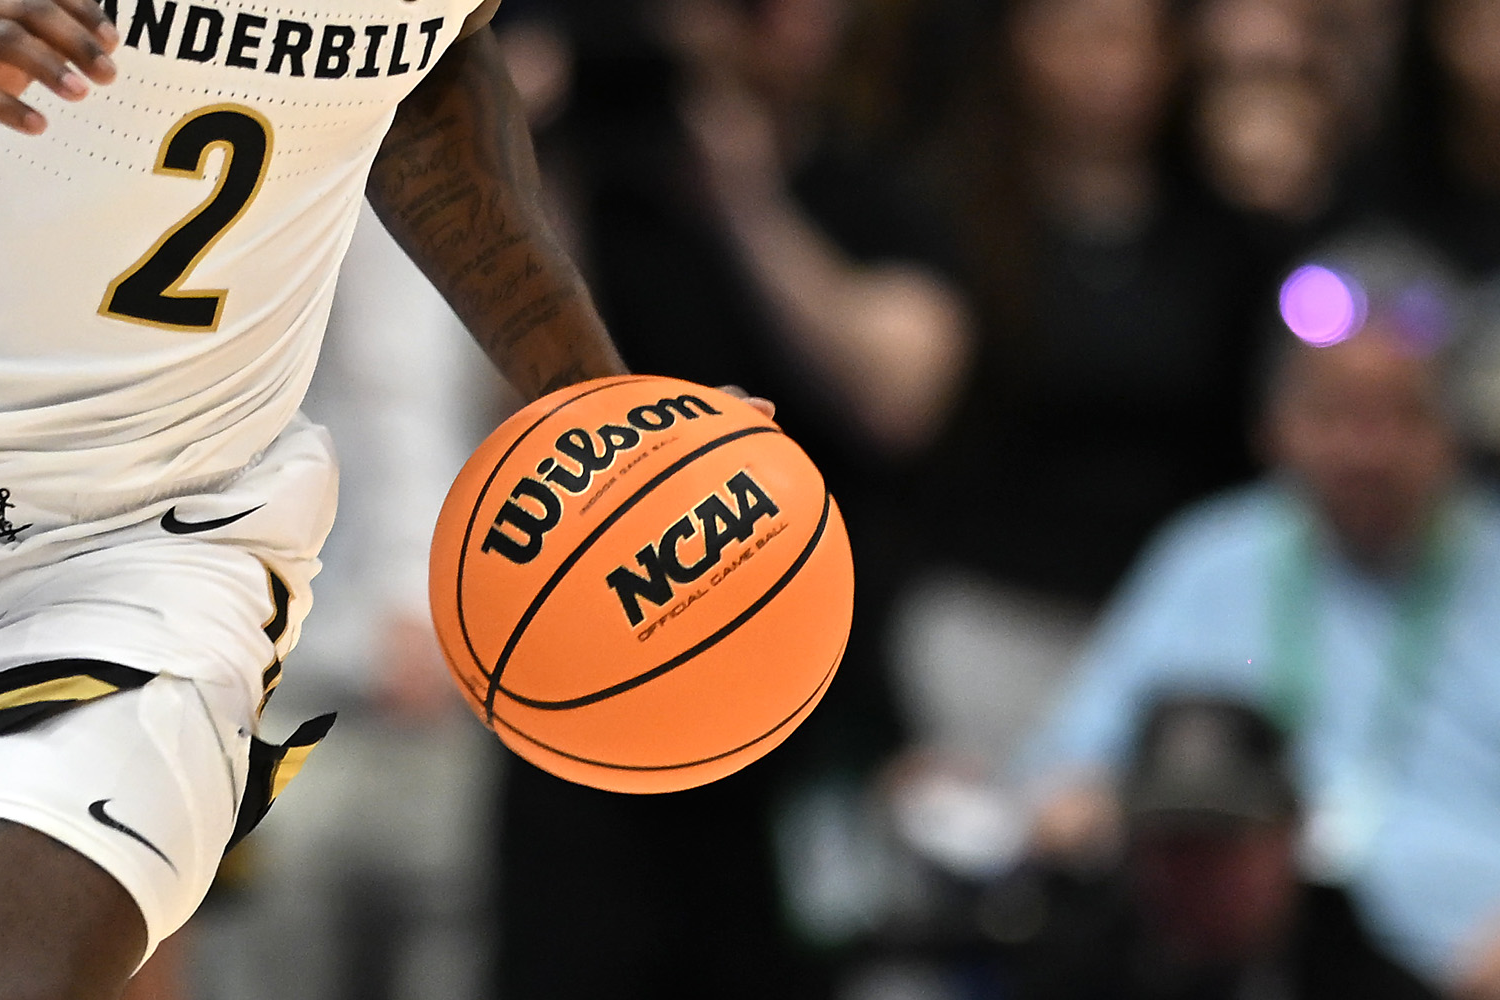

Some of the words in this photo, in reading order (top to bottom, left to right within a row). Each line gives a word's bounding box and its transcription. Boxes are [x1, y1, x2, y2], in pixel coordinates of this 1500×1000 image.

[98, 102, 274, 333] 2
[482, 393, 722, 566] Wilson
[605, 470, 780, 628] NCAA
[637, 588, 709, 642] OFFICIAL
[710, 548, 753, 586] GAME
[755, 522, 789, 550] BALL
